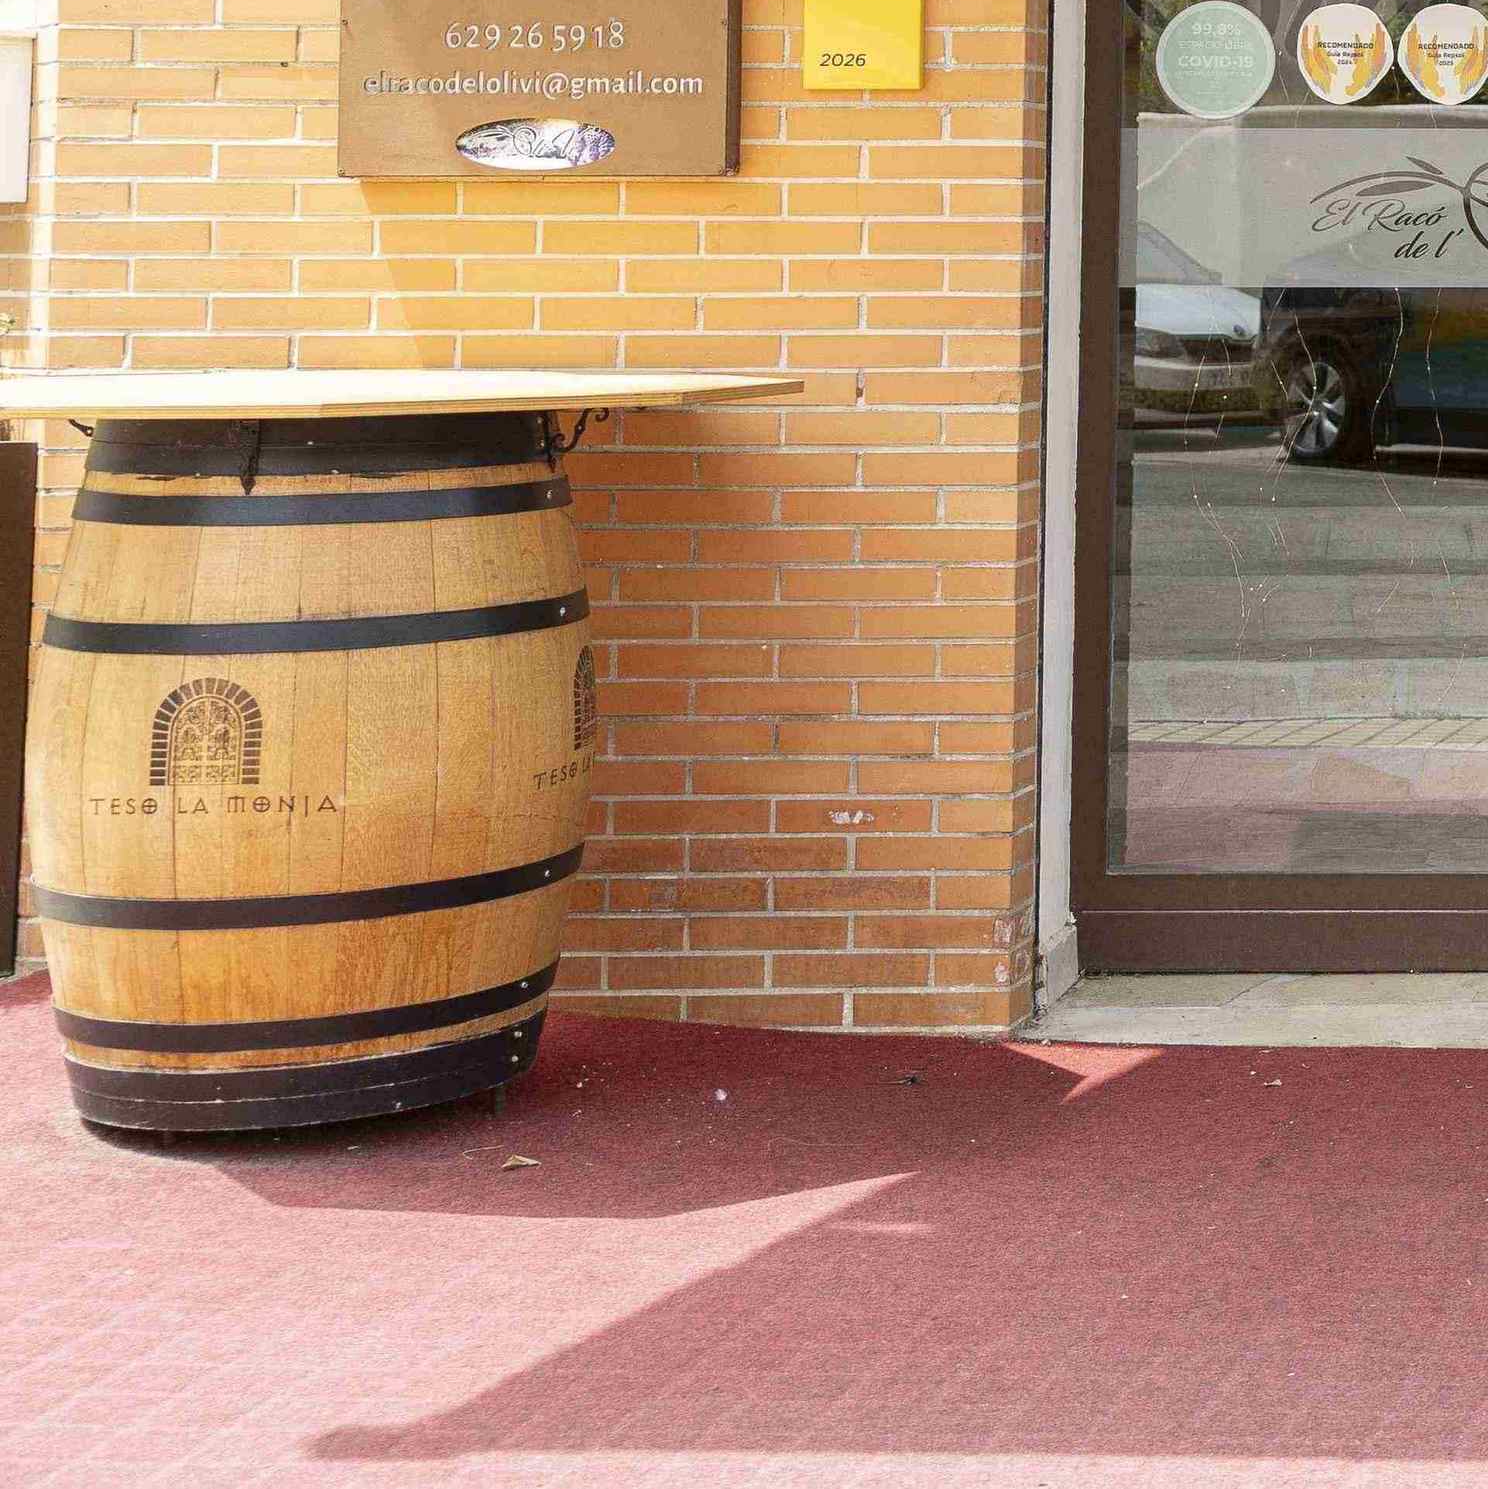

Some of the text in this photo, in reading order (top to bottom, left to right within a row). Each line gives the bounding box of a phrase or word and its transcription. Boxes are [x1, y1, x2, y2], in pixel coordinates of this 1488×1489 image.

[444, 22, 500, 50] 629
[510, 23, 543, 49] 26
[1317, 41, 1375, 49] RECOMENDADO
[1418, 42, 1475, 50] RECOMENDADO
[820, 53, 867, 67] 2026
[1177, 55, 1255, 68] COVID-19
[363, 71, 704, 100] elracodelolivi@gmail.com
[1312, 198, 1448, 232] El Racó
[1394, 231, 1432, 259] de
[533, 762, 578, 791] TESO
[89, 798, 159, 815] TESO
[177, 797, 209, 814] LA
